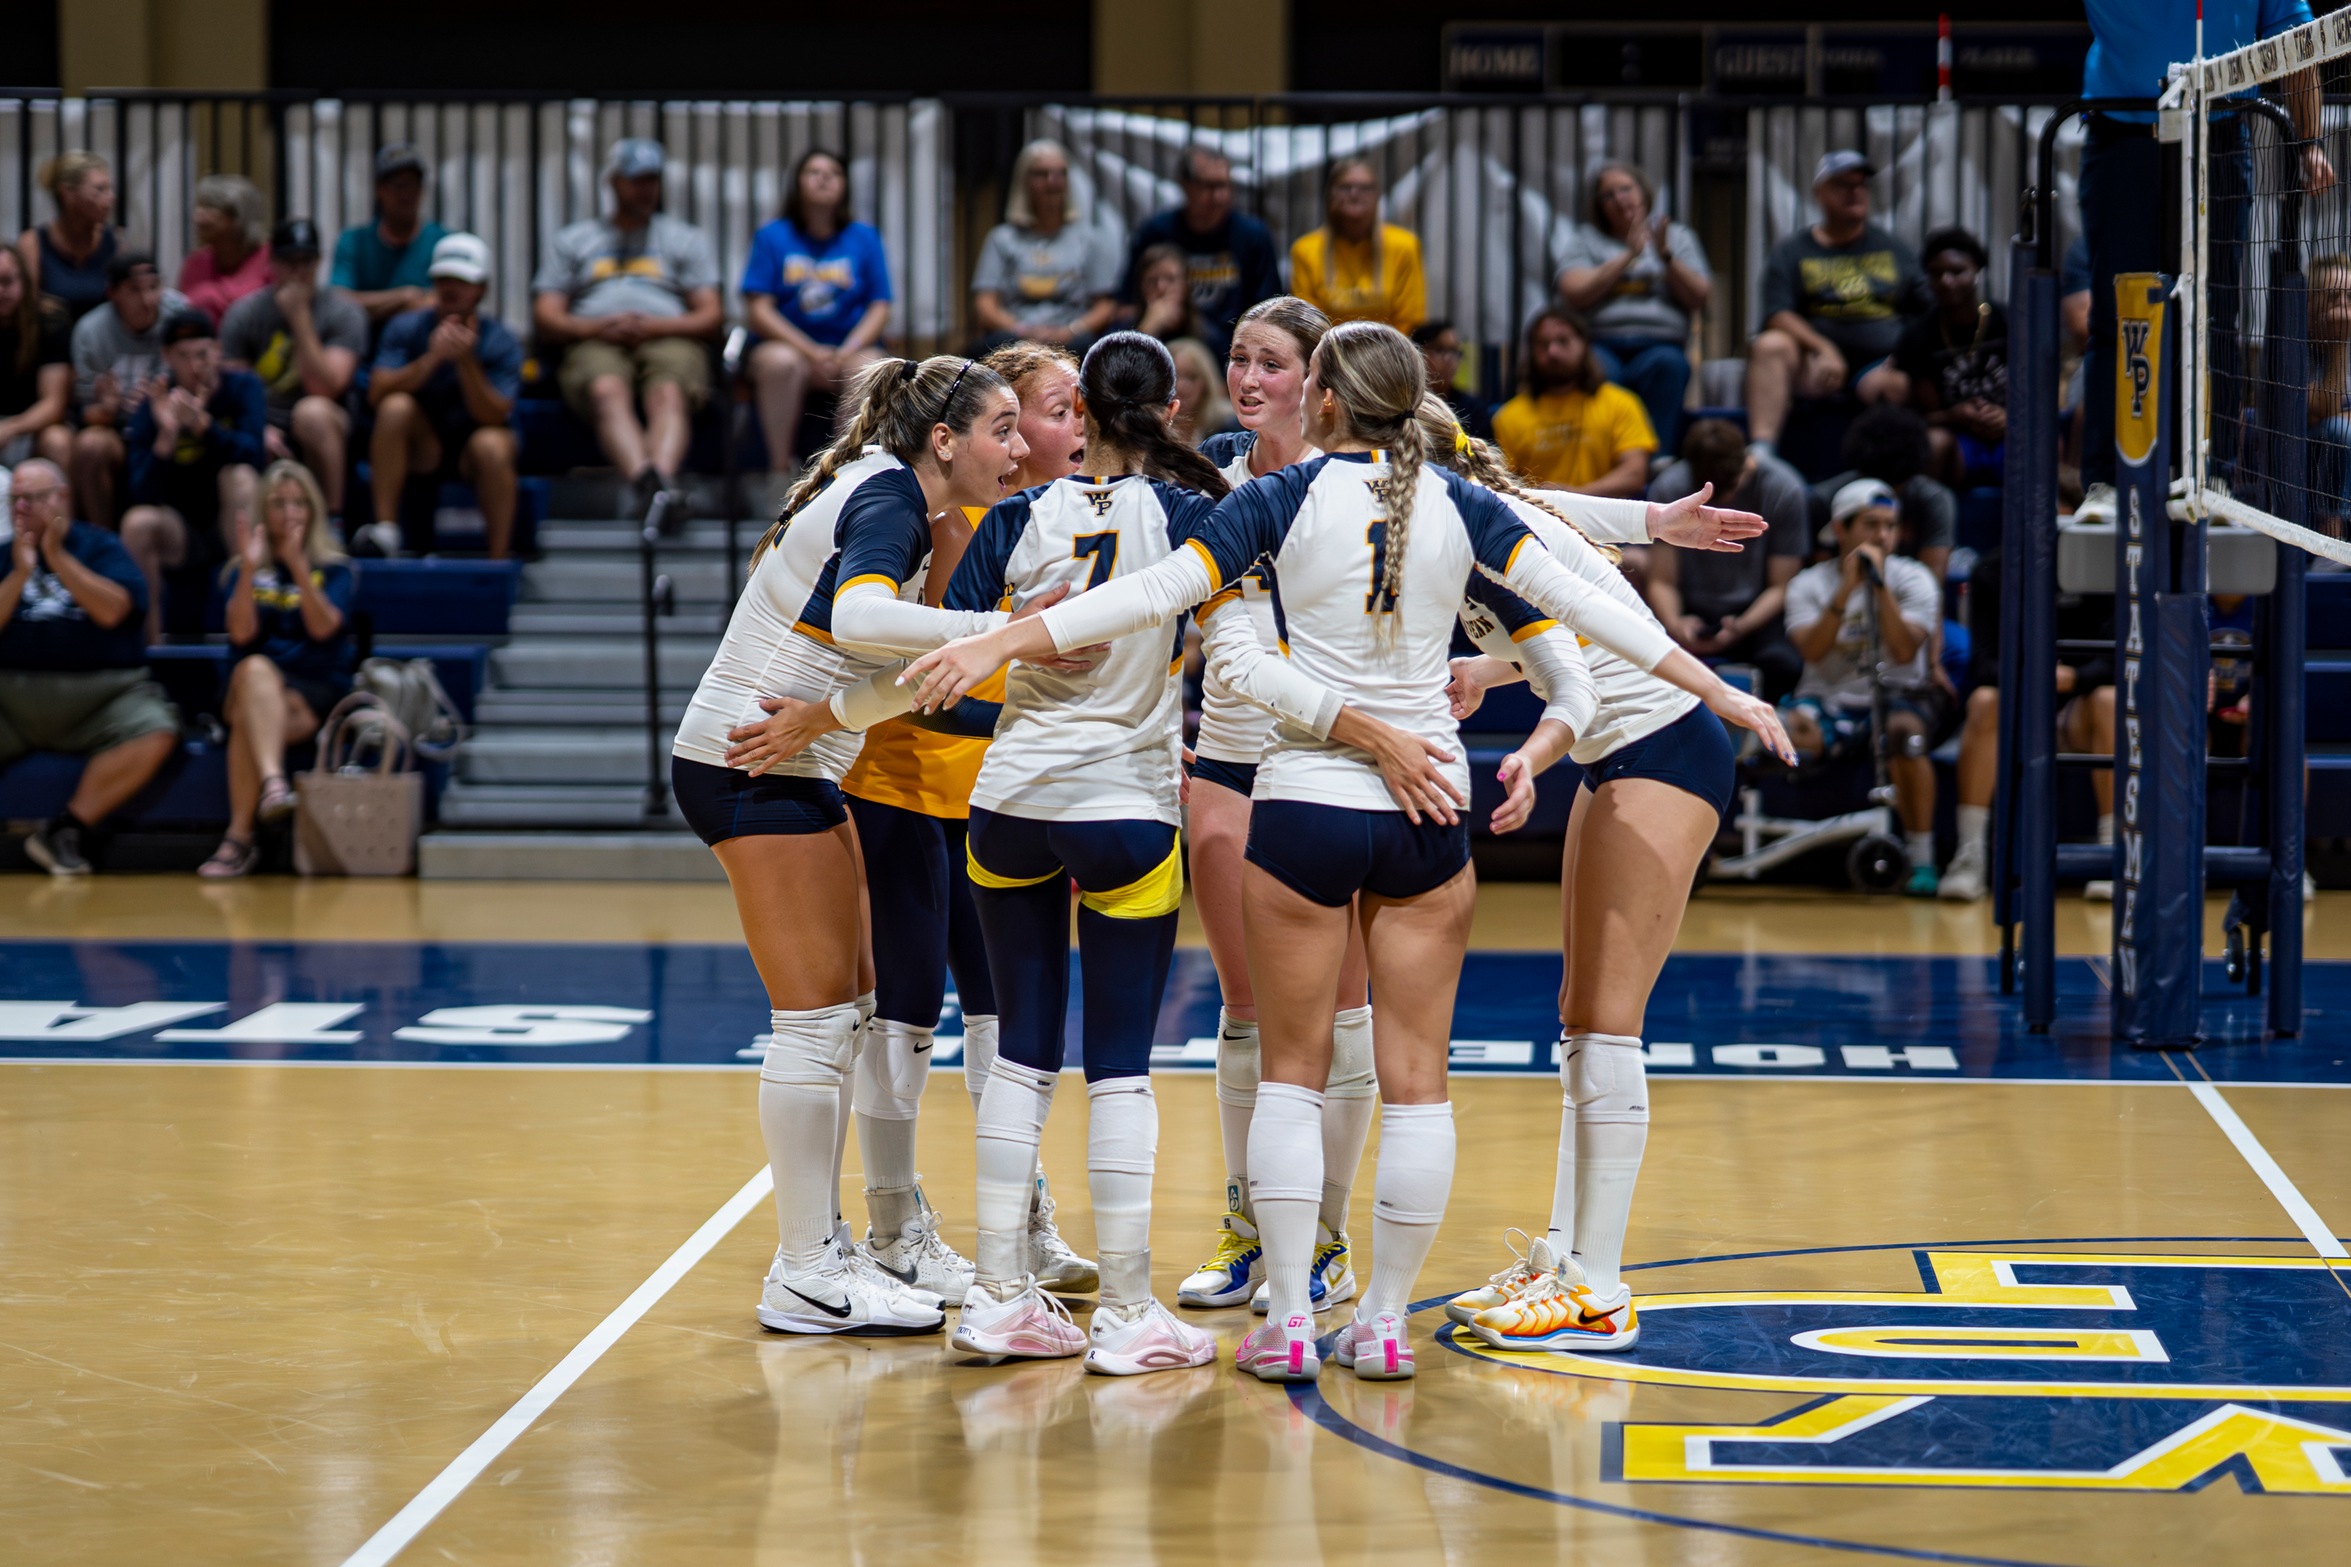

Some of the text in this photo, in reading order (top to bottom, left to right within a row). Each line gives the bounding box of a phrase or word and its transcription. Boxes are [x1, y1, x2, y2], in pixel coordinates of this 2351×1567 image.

[2122, 319, 2151, 418] WP
[1083, 490, 1113, 518] WP
[1071, 529, 1120, 593] 7
[2118, 484, 2144, 997] STATESMEN
[1287, 1316, 1307, 1328] GT
